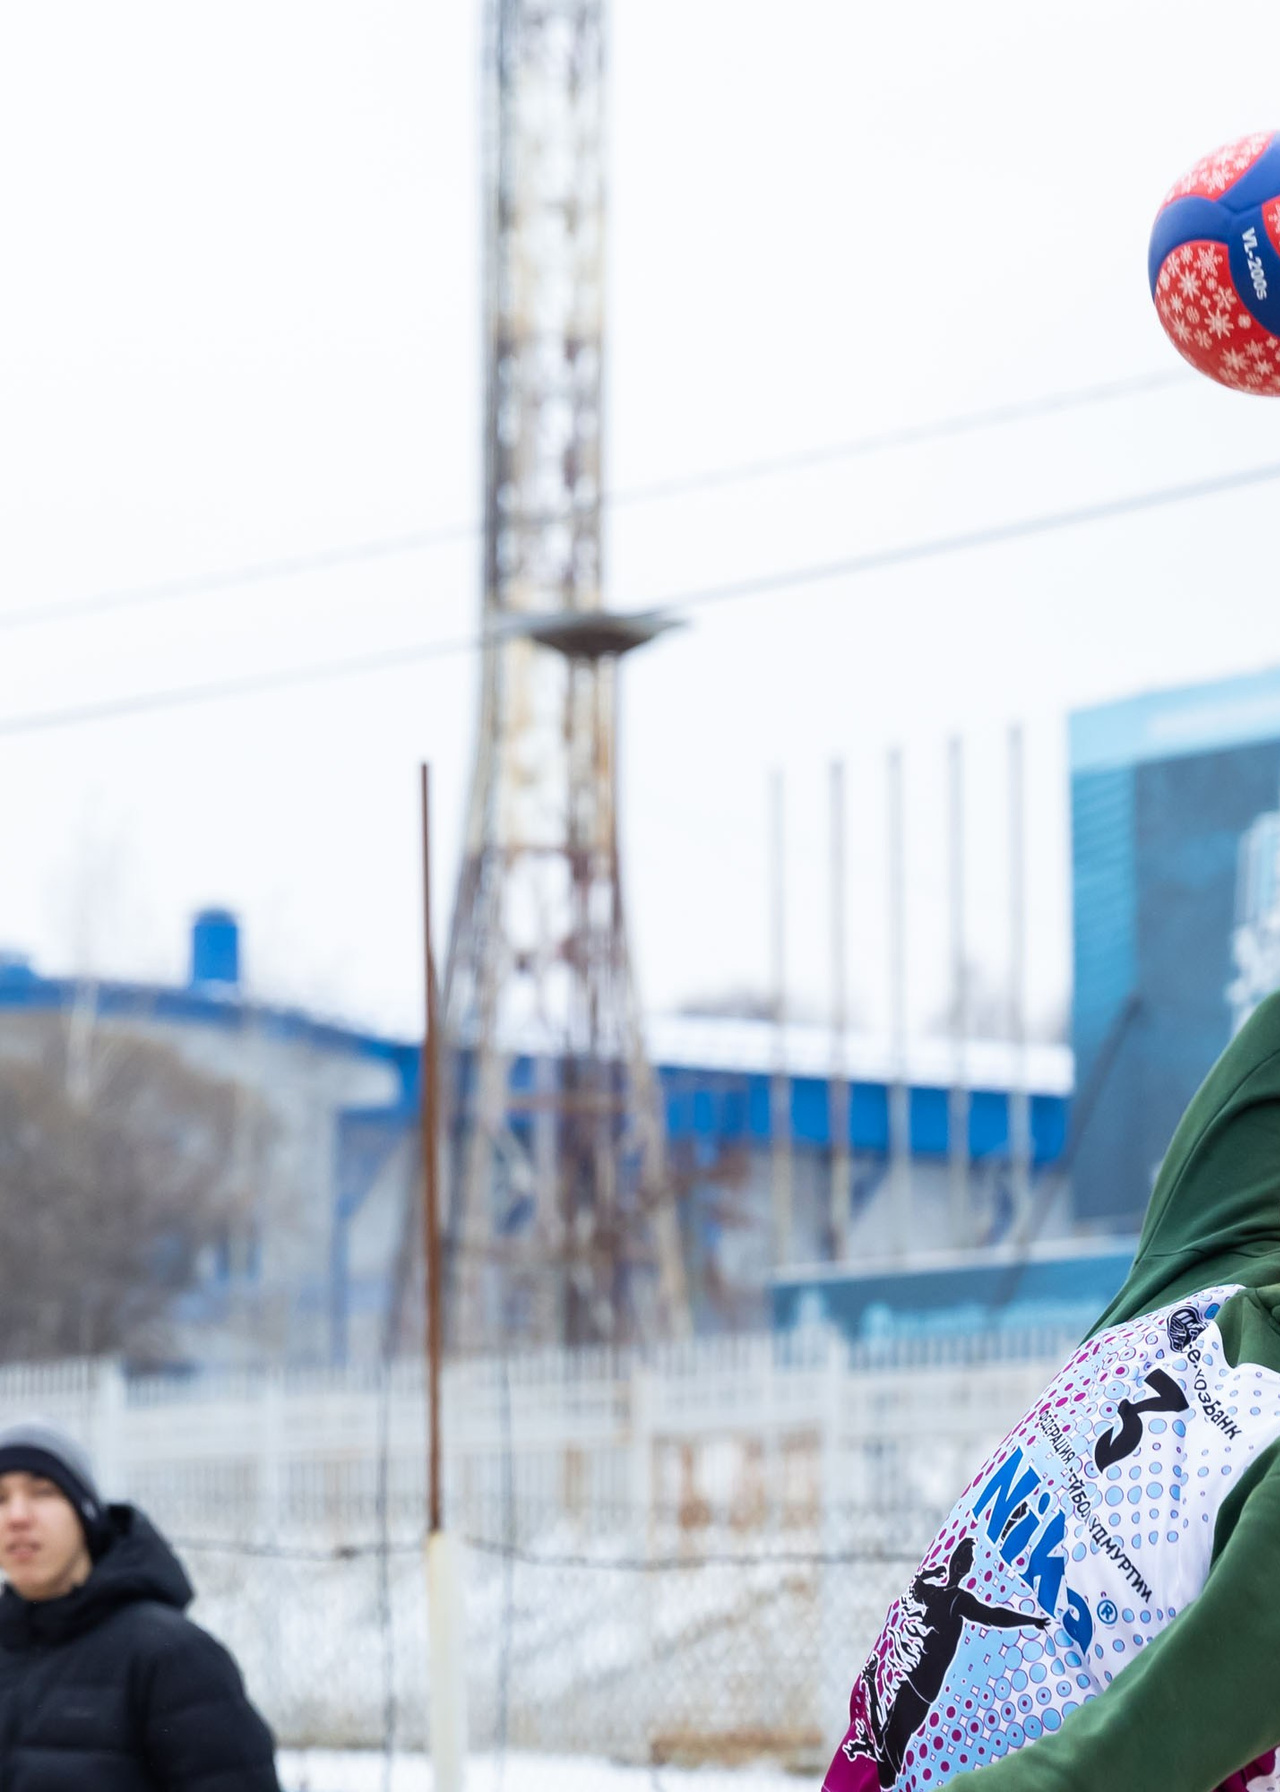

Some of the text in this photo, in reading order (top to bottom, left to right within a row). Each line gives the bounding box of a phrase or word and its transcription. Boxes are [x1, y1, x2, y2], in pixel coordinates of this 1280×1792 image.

[1094, 1368, 1190, 1473] 3
[1038, 1410, 1076, 1466] ФЕДЕРАЦИЯ
[1088, 1517, 1153, 1604] УДМУРТИИ
